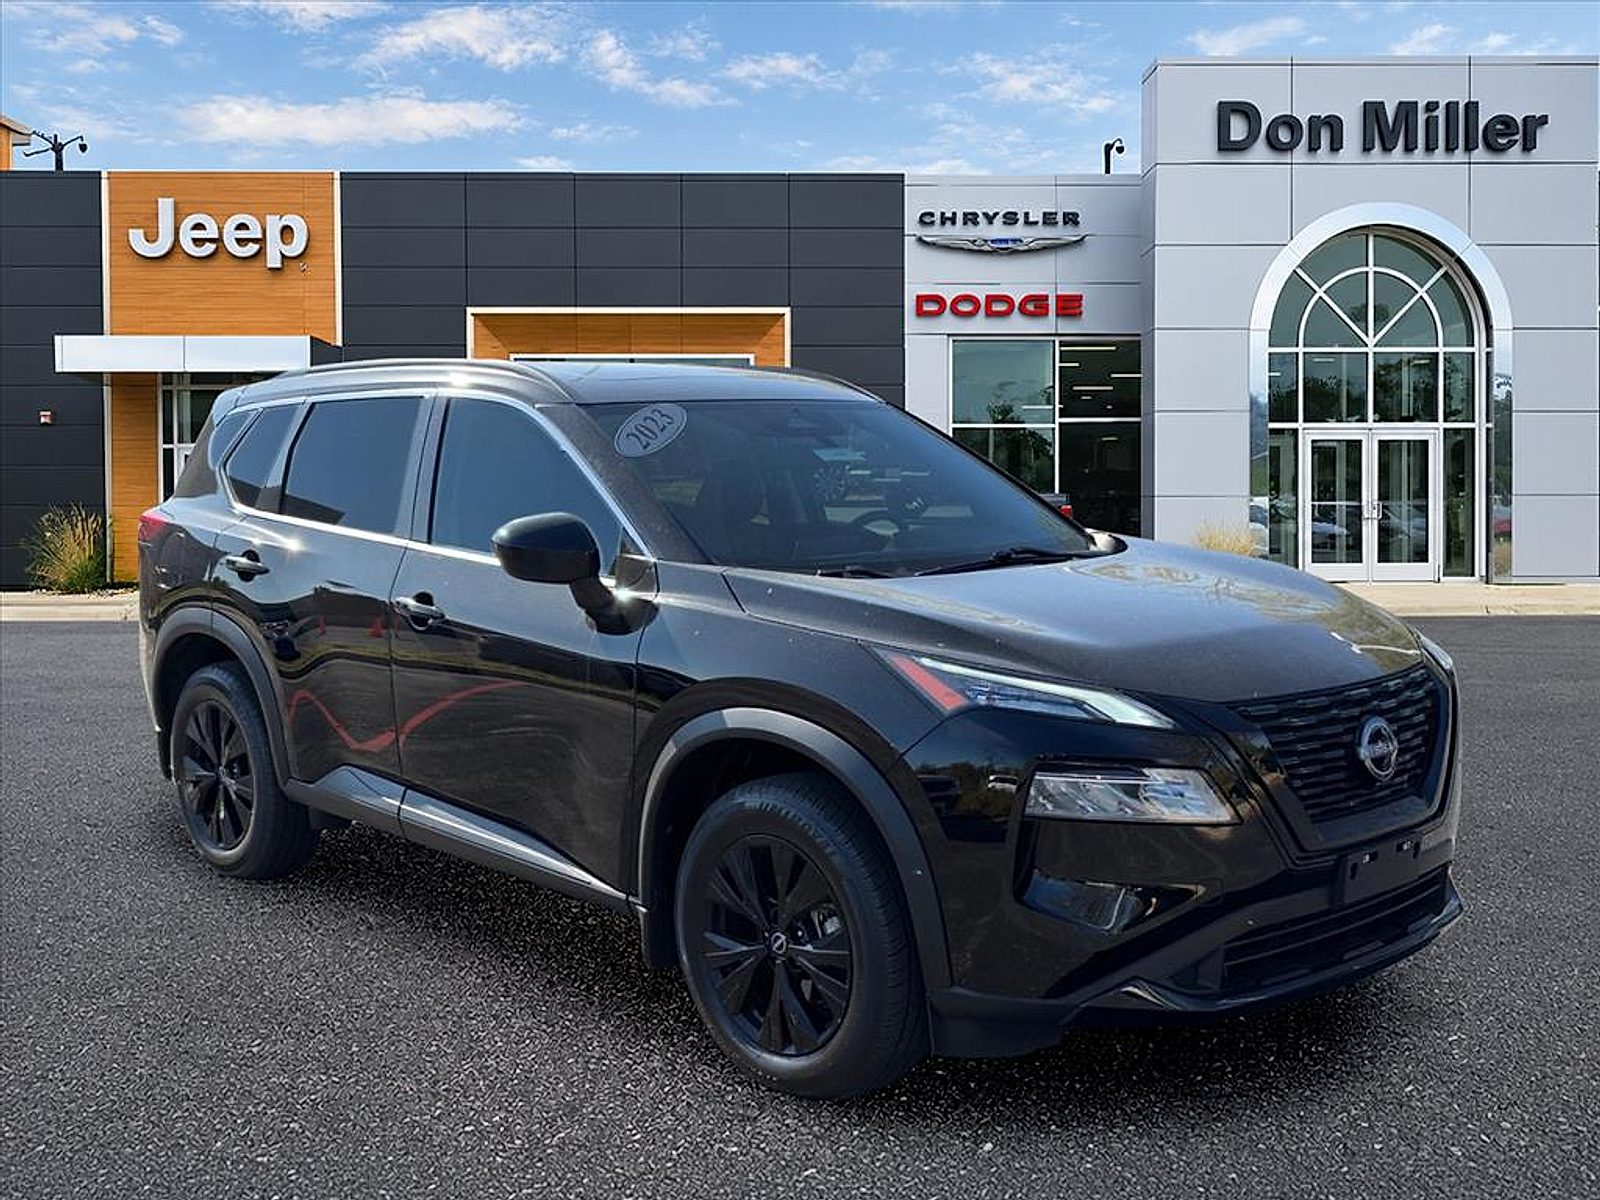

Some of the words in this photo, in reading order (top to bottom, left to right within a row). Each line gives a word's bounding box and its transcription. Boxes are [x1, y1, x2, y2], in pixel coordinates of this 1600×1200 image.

[1217, 100, 1344, 152] Don
[1362, 100, 1548, 152] Miller
[128, 197, 309, 269] Jeep
[917, 210, 1080, 227] CHRYSLER
[915, 294, 1084, 317] DODGE
[626, 409, 674, 449] 2023
